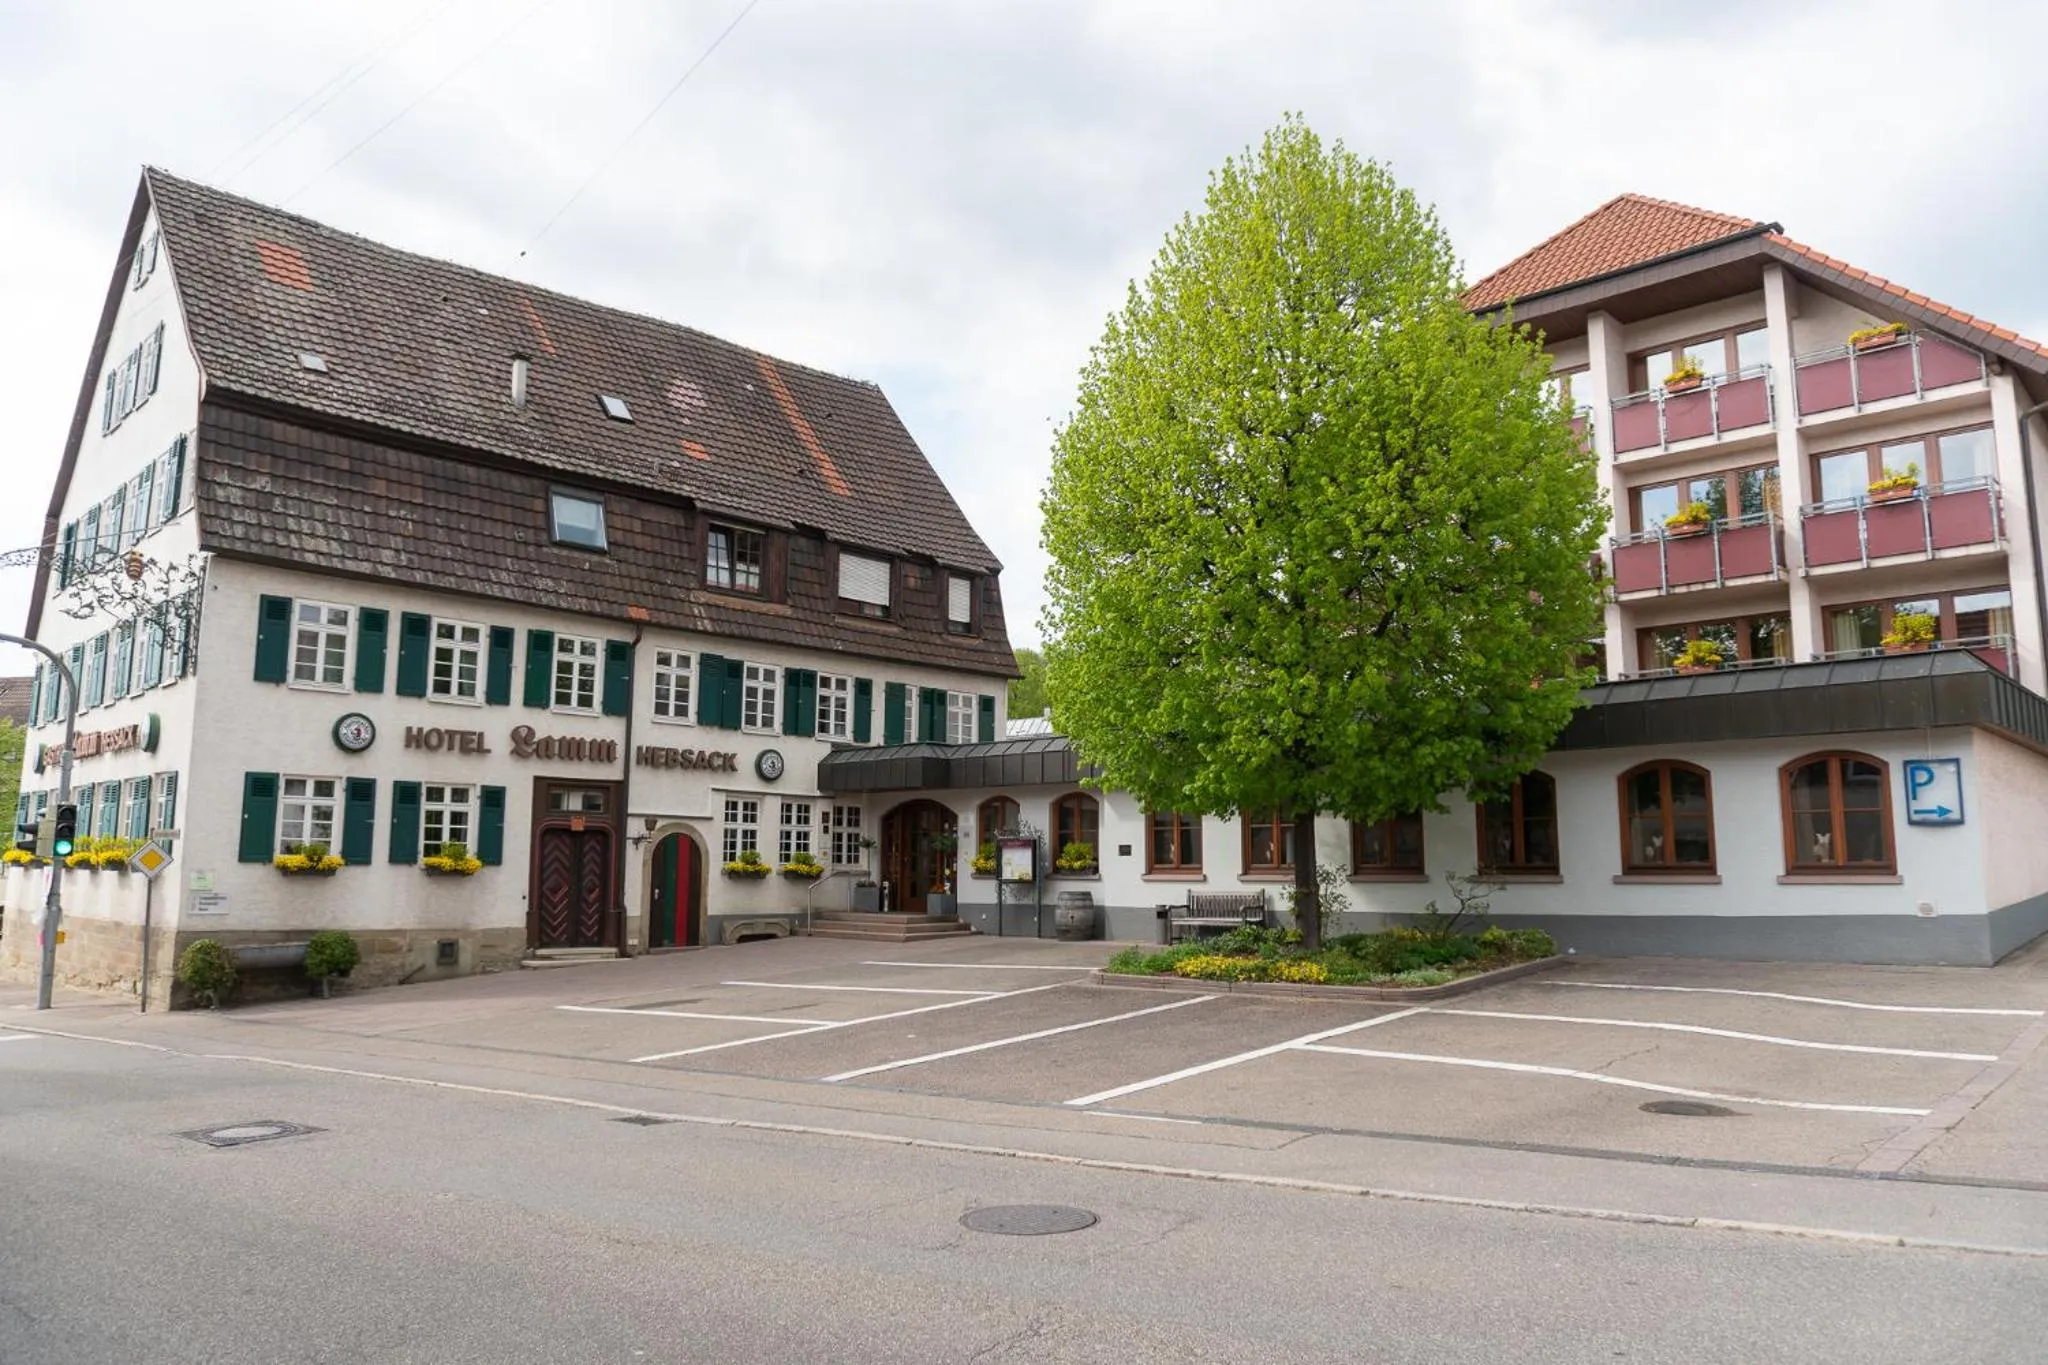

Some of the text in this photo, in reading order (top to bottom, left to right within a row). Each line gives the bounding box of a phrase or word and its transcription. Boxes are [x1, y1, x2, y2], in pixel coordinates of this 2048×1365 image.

[404, 726, 492, 754] HOTEL
[509, 725, 618, 764] Lamm
[636, 745, 738, 772] HEBSACK
[1910, 765, 1934, 801] P
